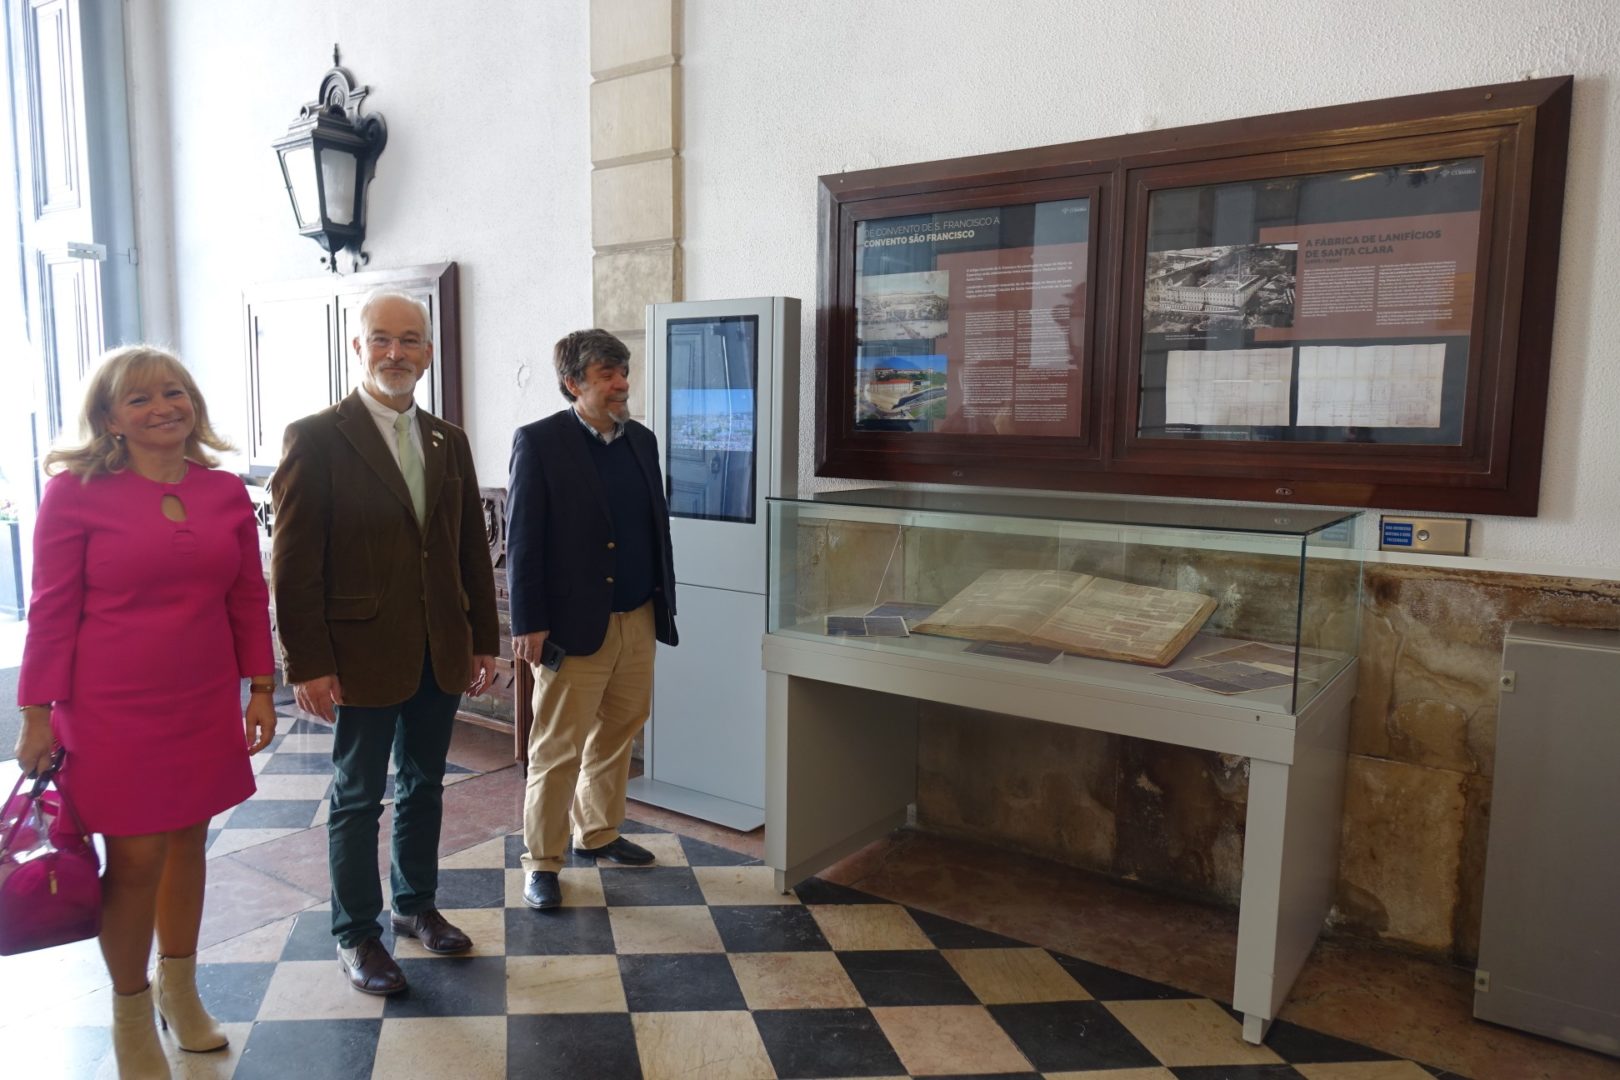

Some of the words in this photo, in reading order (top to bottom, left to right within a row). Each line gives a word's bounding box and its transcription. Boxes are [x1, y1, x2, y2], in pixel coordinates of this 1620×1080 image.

[875, 224, 920, 236] CONVENTO
[921, 222, 933, 232] DE
[934, 222, 942, 231] S.
[943, 217, 992, 229] FRANCISCO
[993, 216, 1000, 225] A
[864, 235, 908, 248] CONVENTO
[908, 232, 926, 243] SÃO
[926, 229, 975, 242] FRANCISCO
[1305, 239, 1313, 247] A
[1314, 236, 1359, 246] FÁBRICA
[1361, 234, 1376, 244] DE
[1378, 229, 1442, 243] LANIFÍCIOS
[1305, 250, 1319, 258] DE
[1321, 247, 1356, 258] SANTA
[1357, 245, 1394, 255] CLARA
